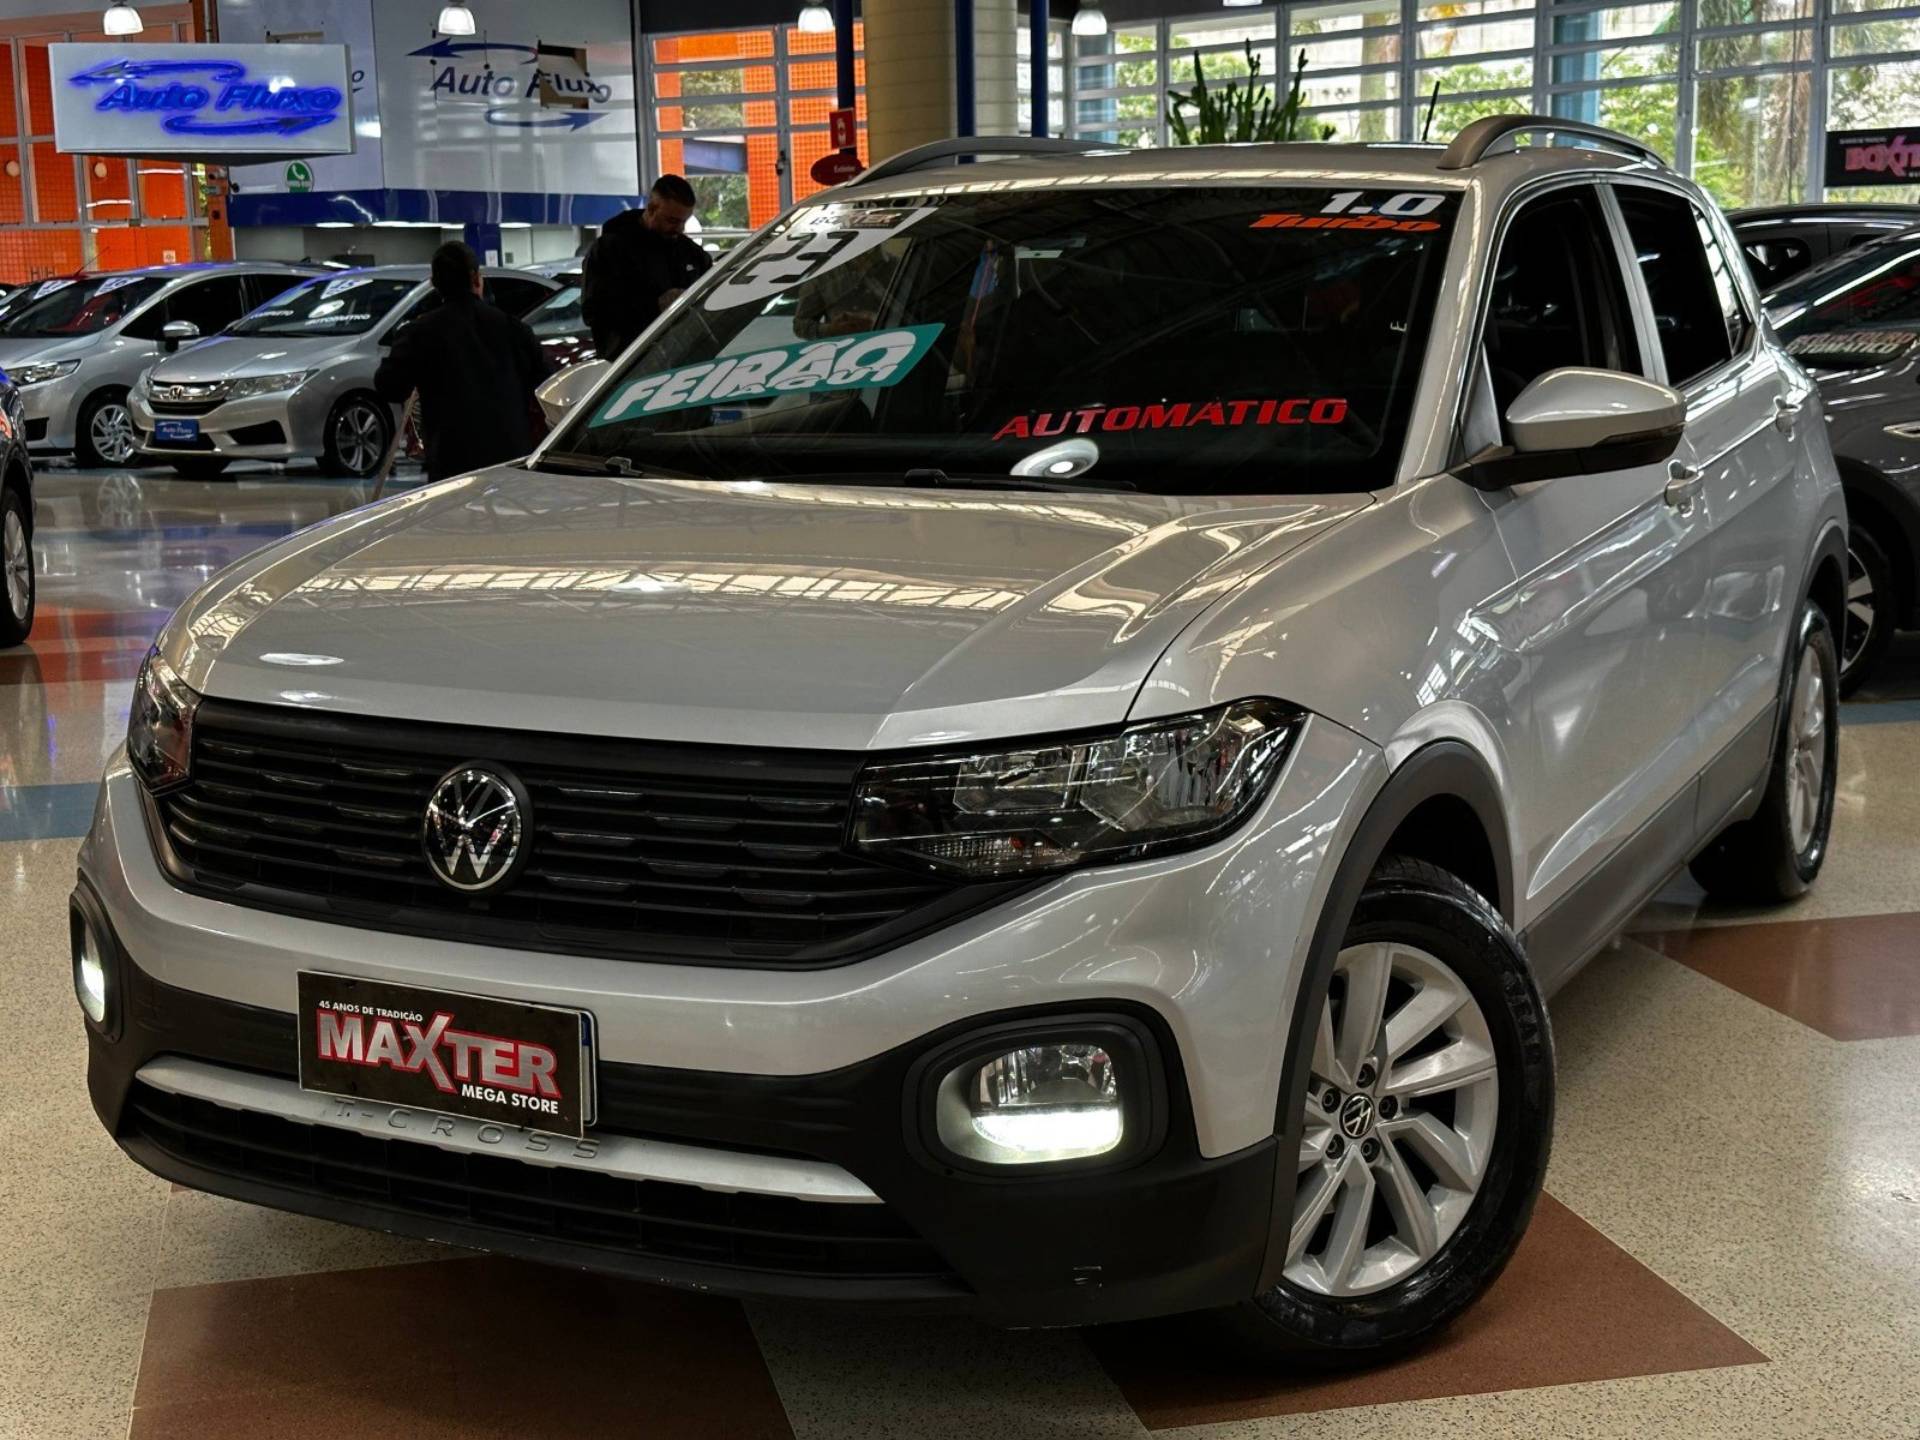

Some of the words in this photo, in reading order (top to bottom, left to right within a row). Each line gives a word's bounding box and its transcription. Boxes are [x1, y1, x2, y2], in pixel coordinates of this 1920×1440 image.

[97, 82, 208, 110] Auto
[216, 82, 341, 110] Fluxo
[430, 66, 516, 97] Auto
[525, 68, 612, 104] Fluxo
[1320, 192, 1446, 216] 1.0
[1250, 214, 1441, 232] Turbo
[728, 230, 860, 285] 23
[603, 331, 916, 420] FEIRÃO
[319, 1000, 330, 1009] 45
[332, 1001, 360, 1013] ANOS
[362, 1006, 374, 1015] DE
[376, 1008, 423, 1022] TRADIÇÃO
[316, 1010, 561, 1099] MAXTER
[461, 1084, 507, 1104] MEGA
[511, 1093, 558, 1115] STORE
[334, 1097, 600, 1158] T-CROSS
